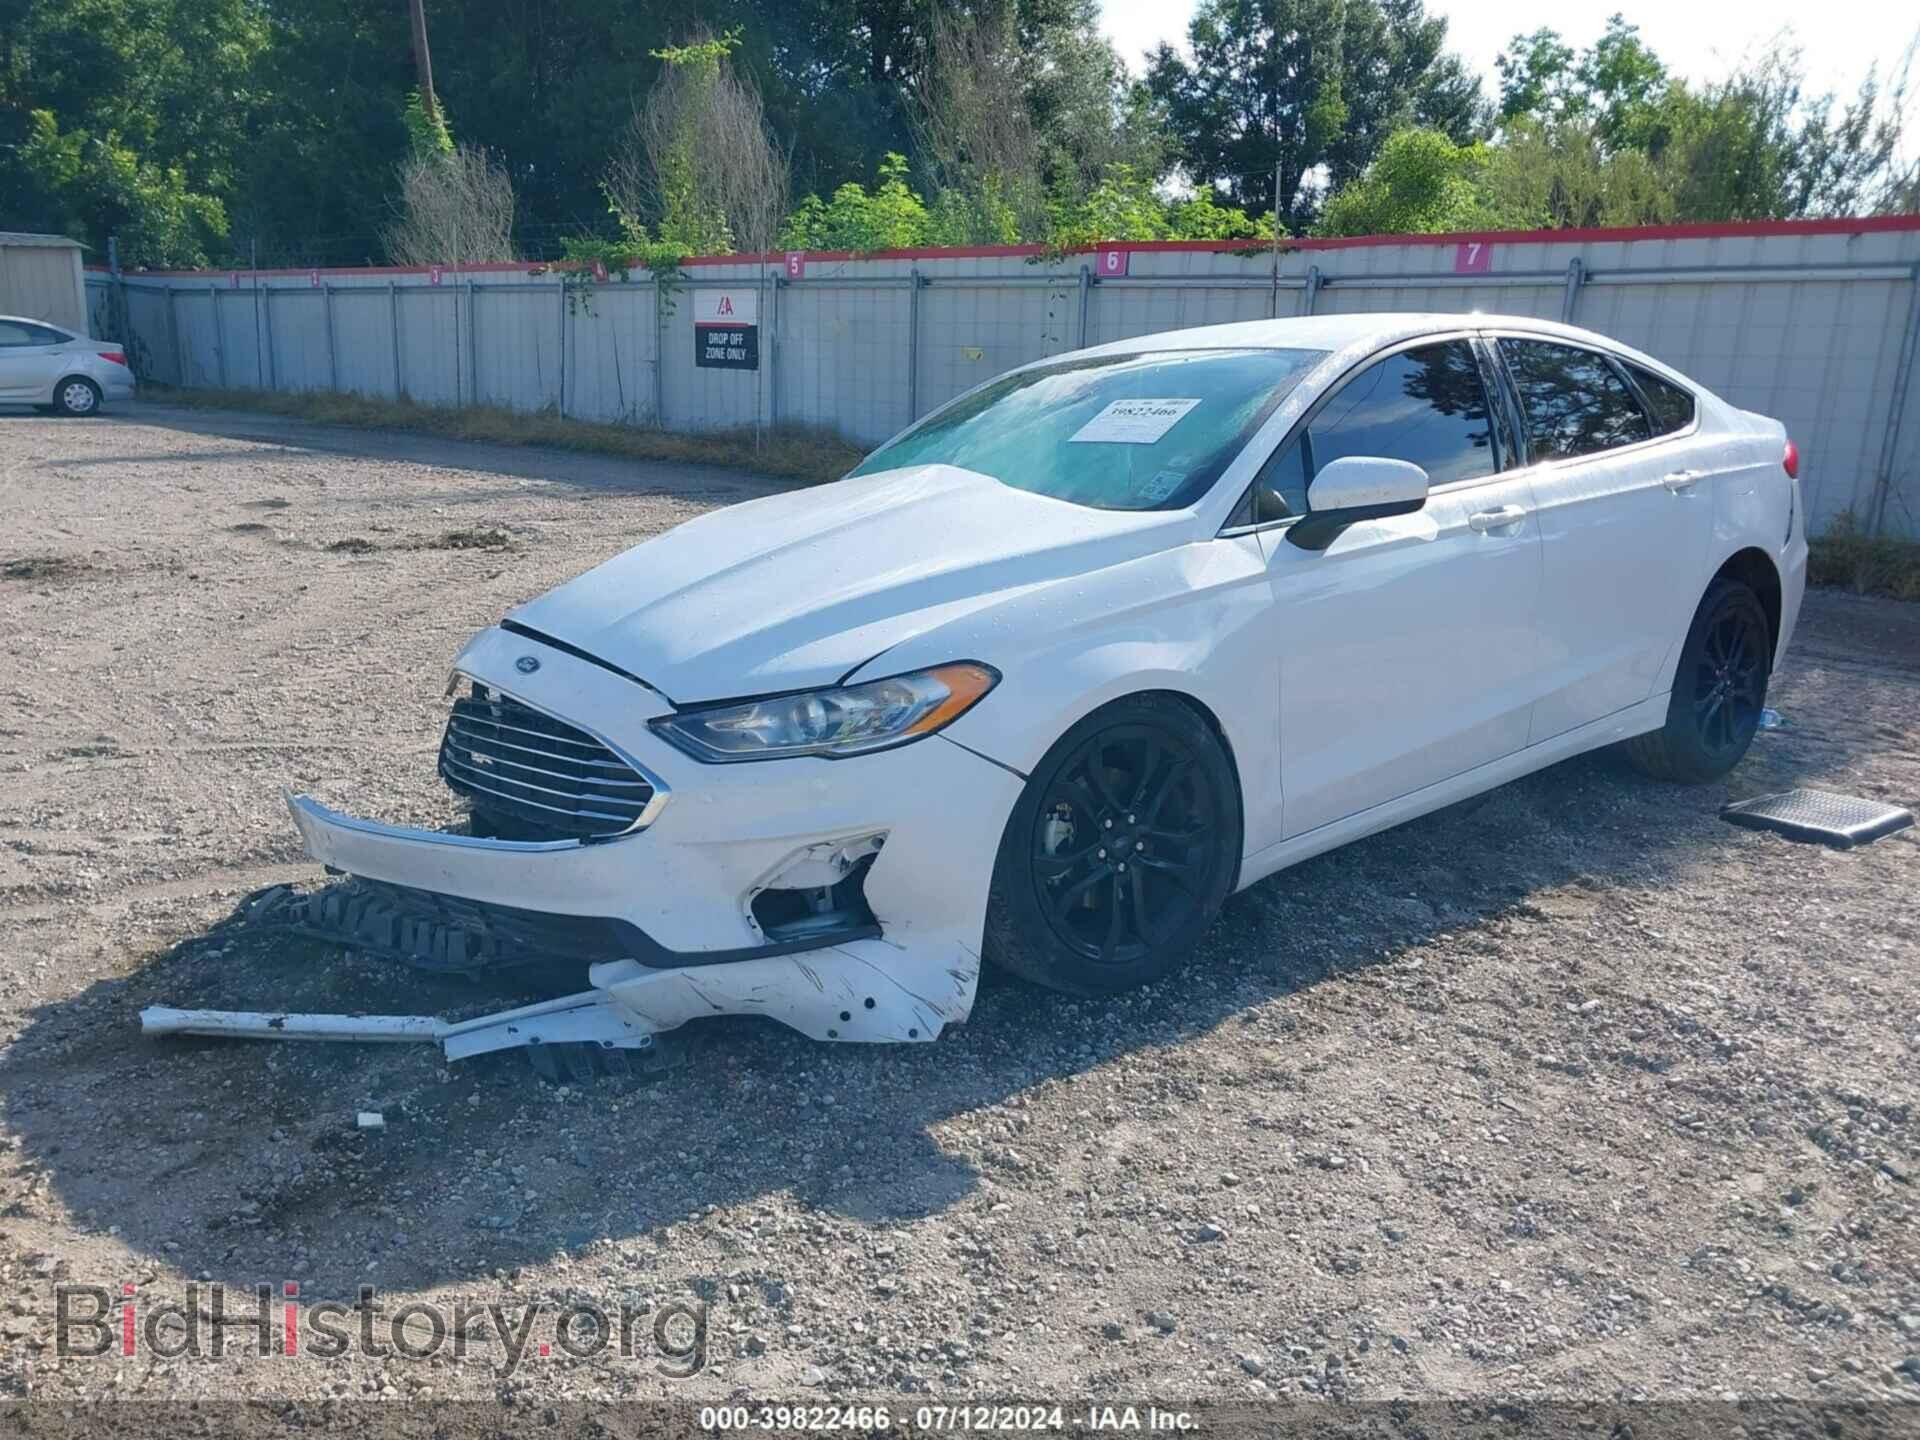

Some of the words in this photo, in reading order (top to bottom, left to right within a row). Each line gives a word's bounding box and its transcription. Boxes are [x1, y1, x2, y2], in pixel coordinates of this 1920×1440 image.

[1107, 251, 1119, 270] 6
[1467, 243, 1481, 265] 7
[791, 256, 798, 274] 5
[708, 332, 728, 345] DROP
[730, 333, 744, 346] OFF
[705, 347, 726, 360] ZONE
[727, 348, 747, 361] ONLY
